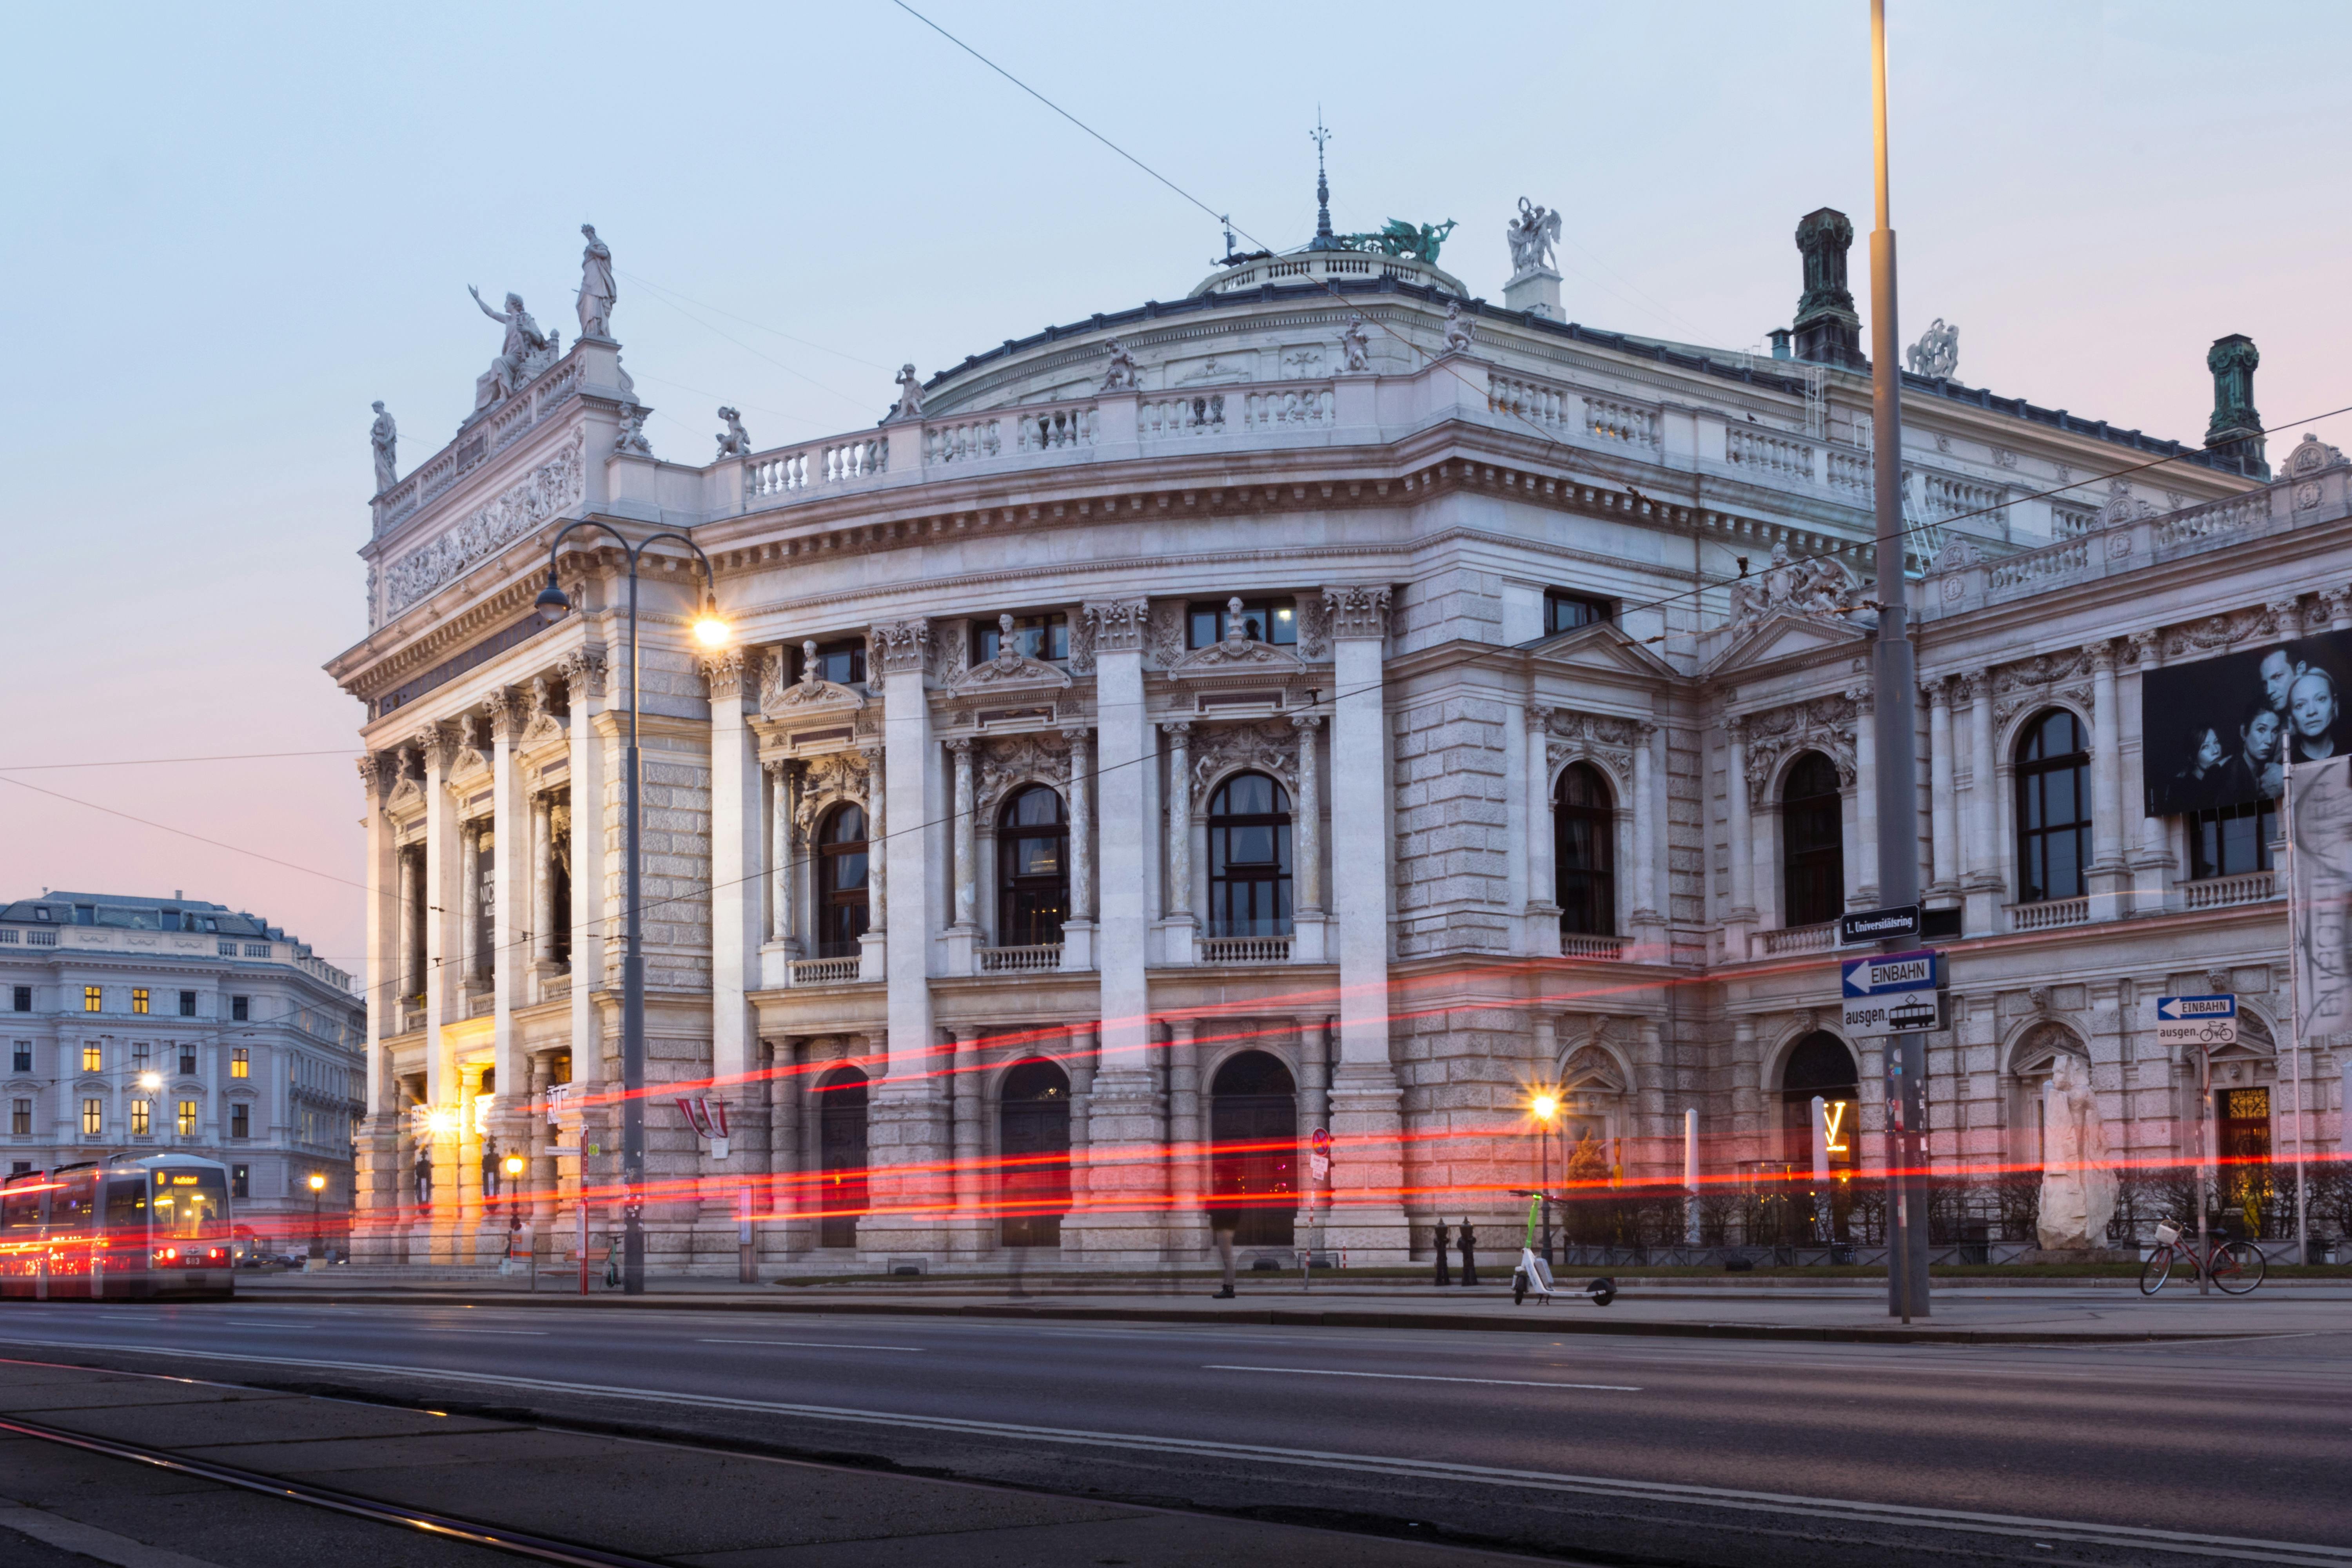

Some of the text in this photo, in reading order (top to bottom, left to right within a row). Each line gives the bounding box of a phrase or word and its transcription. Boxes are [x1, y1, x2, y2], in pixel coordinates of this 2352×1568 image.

[480, 883, 495, 903] NIC
[1855, 916, 1912, 933] Universitätsring
[1872, 962, 1925, 984] EINBAHN
[2182, 1001, 2226, 1013] EINBAHN
[1846, 1008, 1887, 1027] ausgen.
[2160, 1028, 2199, 1038] ausgen.
[157, 1171, 165, 1185] D
